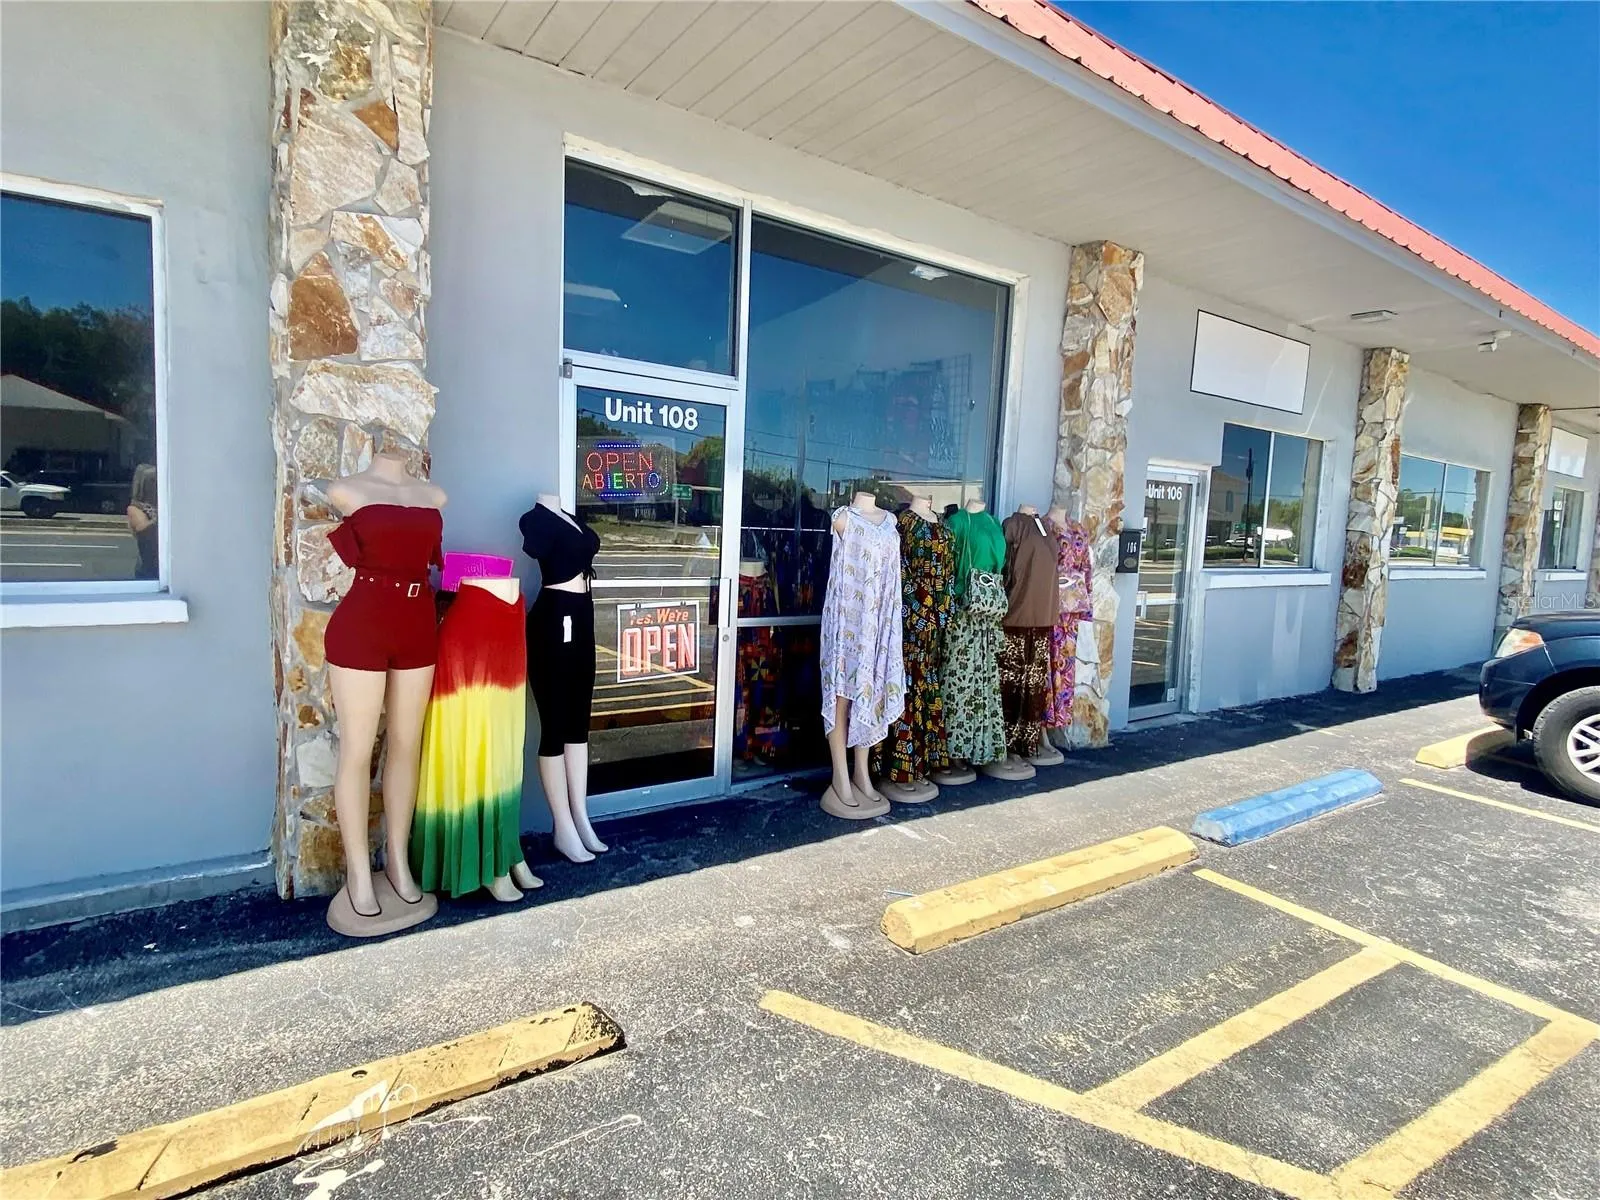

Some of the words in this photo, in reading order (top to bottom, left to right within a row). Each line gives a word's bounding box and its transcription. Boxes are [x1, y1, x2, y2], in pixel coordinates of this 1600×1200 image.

[605, 397, 654, 425] Unit
[659, 404, 698, 431] 108
[586, 451, 654, 472] OPEN
[582, 472, 661, 490] ABIERTO
[1148, 484, 1165, 499] Unit
[1166, 485, 1183, 500] 106
[622, 622, 695, 676] OPEN
